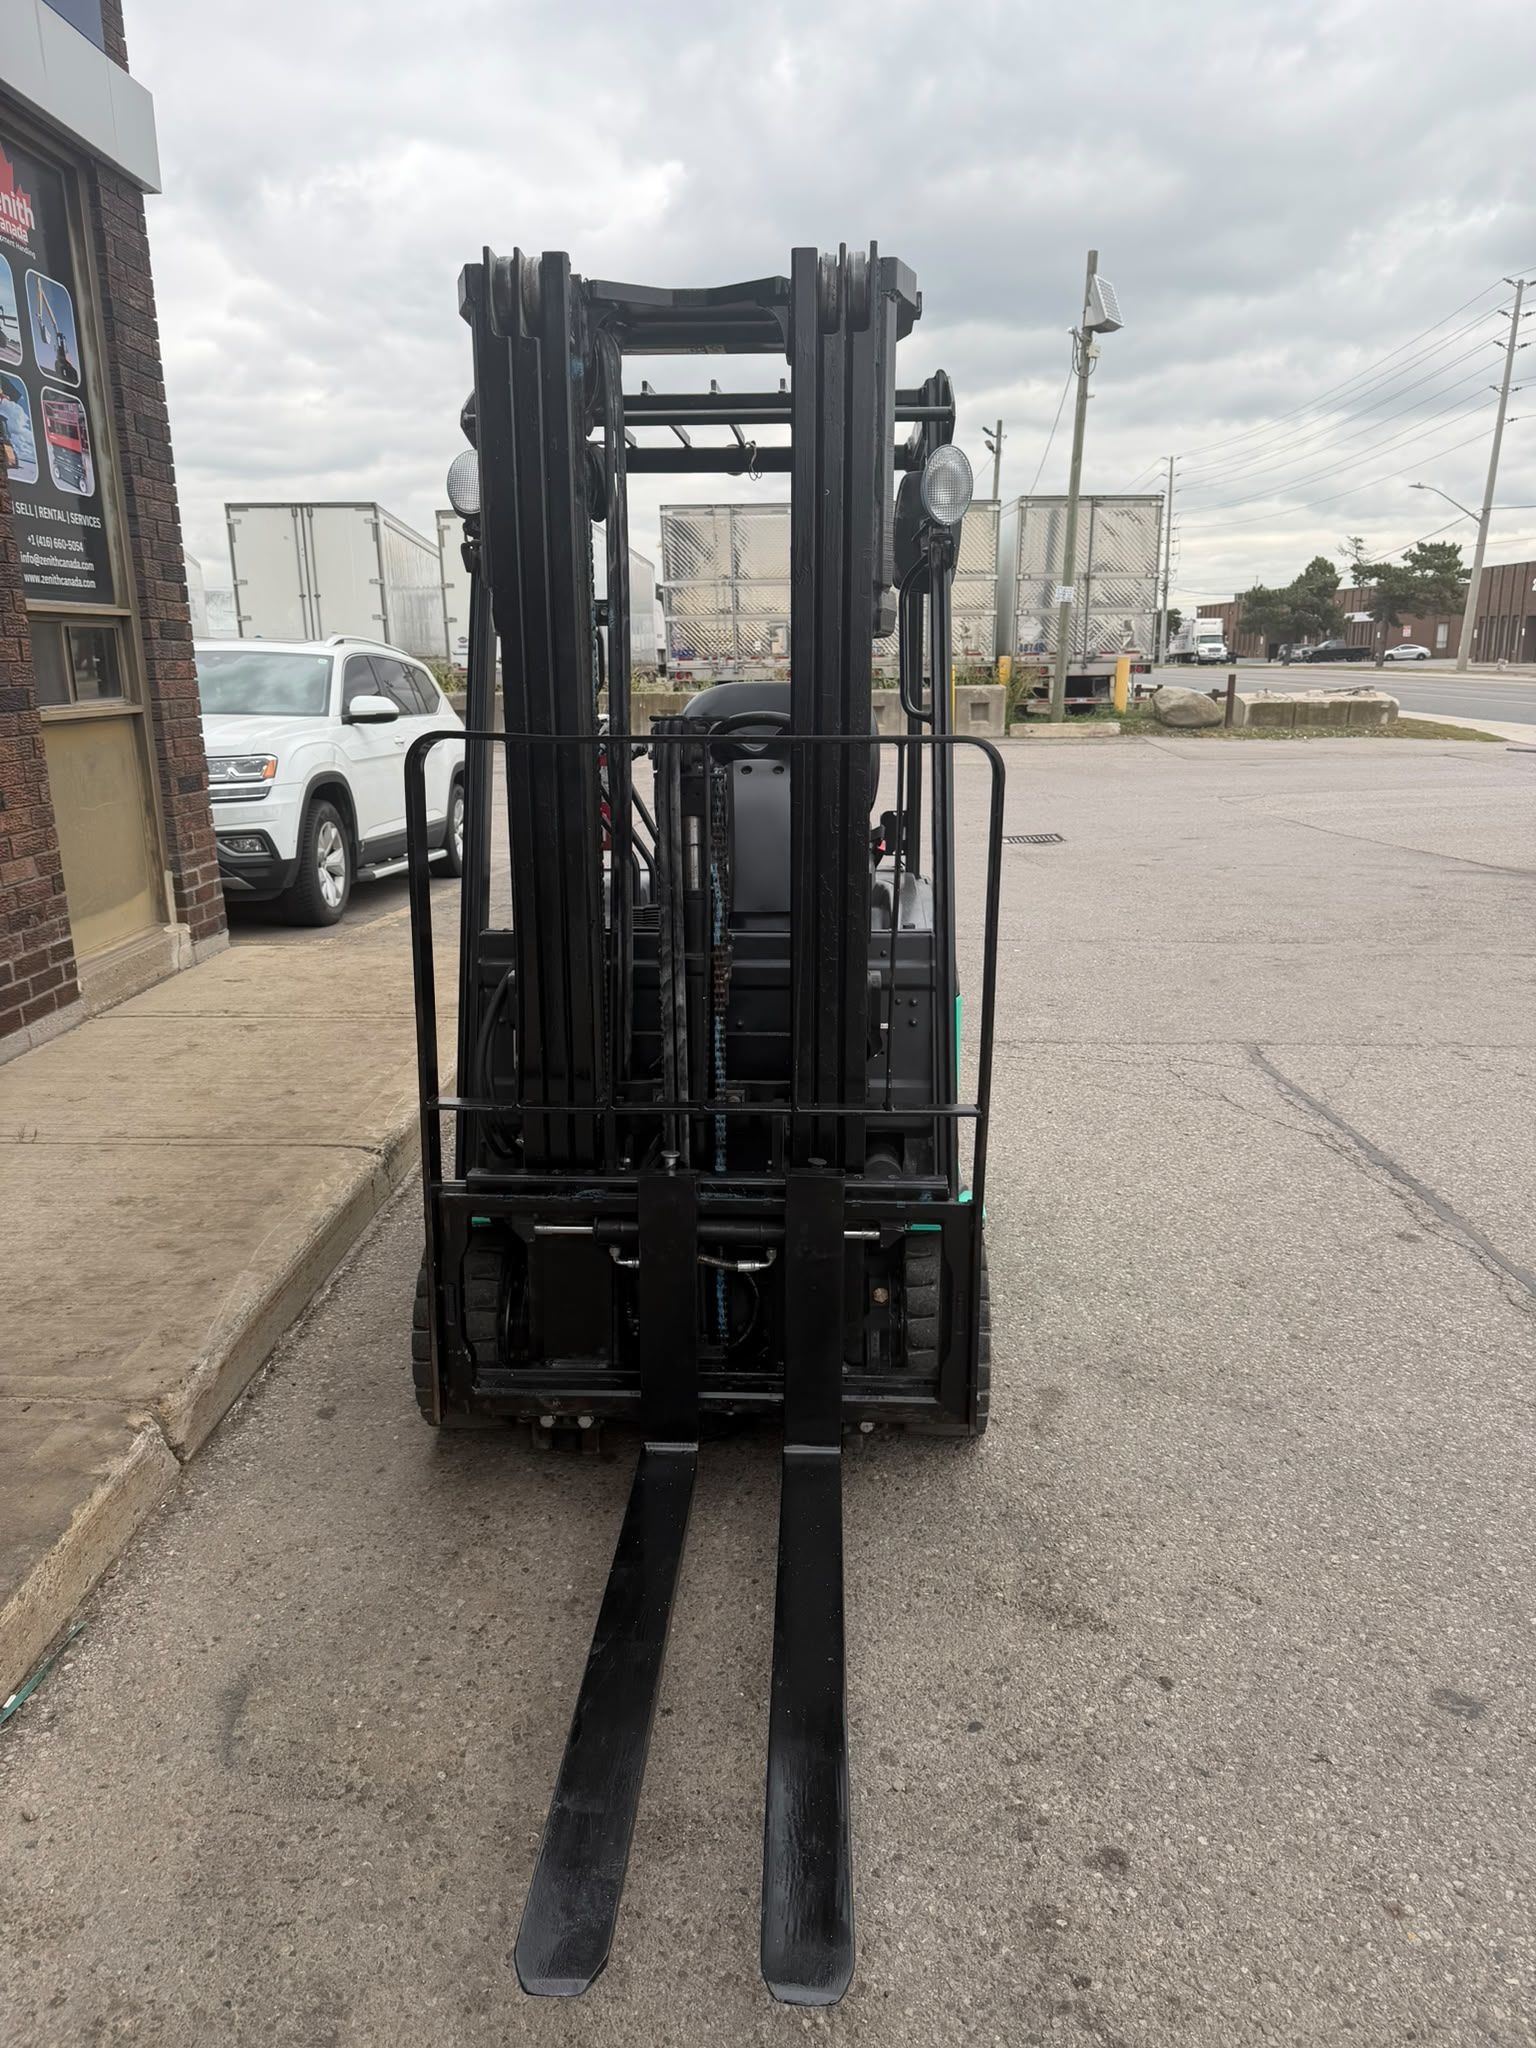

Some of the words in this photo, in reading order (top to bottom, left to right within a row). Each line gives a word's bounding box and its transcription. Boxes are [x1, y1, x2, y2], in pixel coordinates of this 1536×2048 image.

[0, 191, 36, 230] nith
[0, 217, 29, 243] anada
[15, 501, 34, 517] SELL
[38, 506, 66, 522] RENTAL
[70, 512, 102, 529] SERVICES
[27, 534, 36, 546] +1
[36, 534, 53, 549] (416)
[53, 537, 84, 552] 660-5054
[20, 551, 95, 571] info@zenithcanada.com
[23, 573, 96, 589] www.zenithcanada.com
